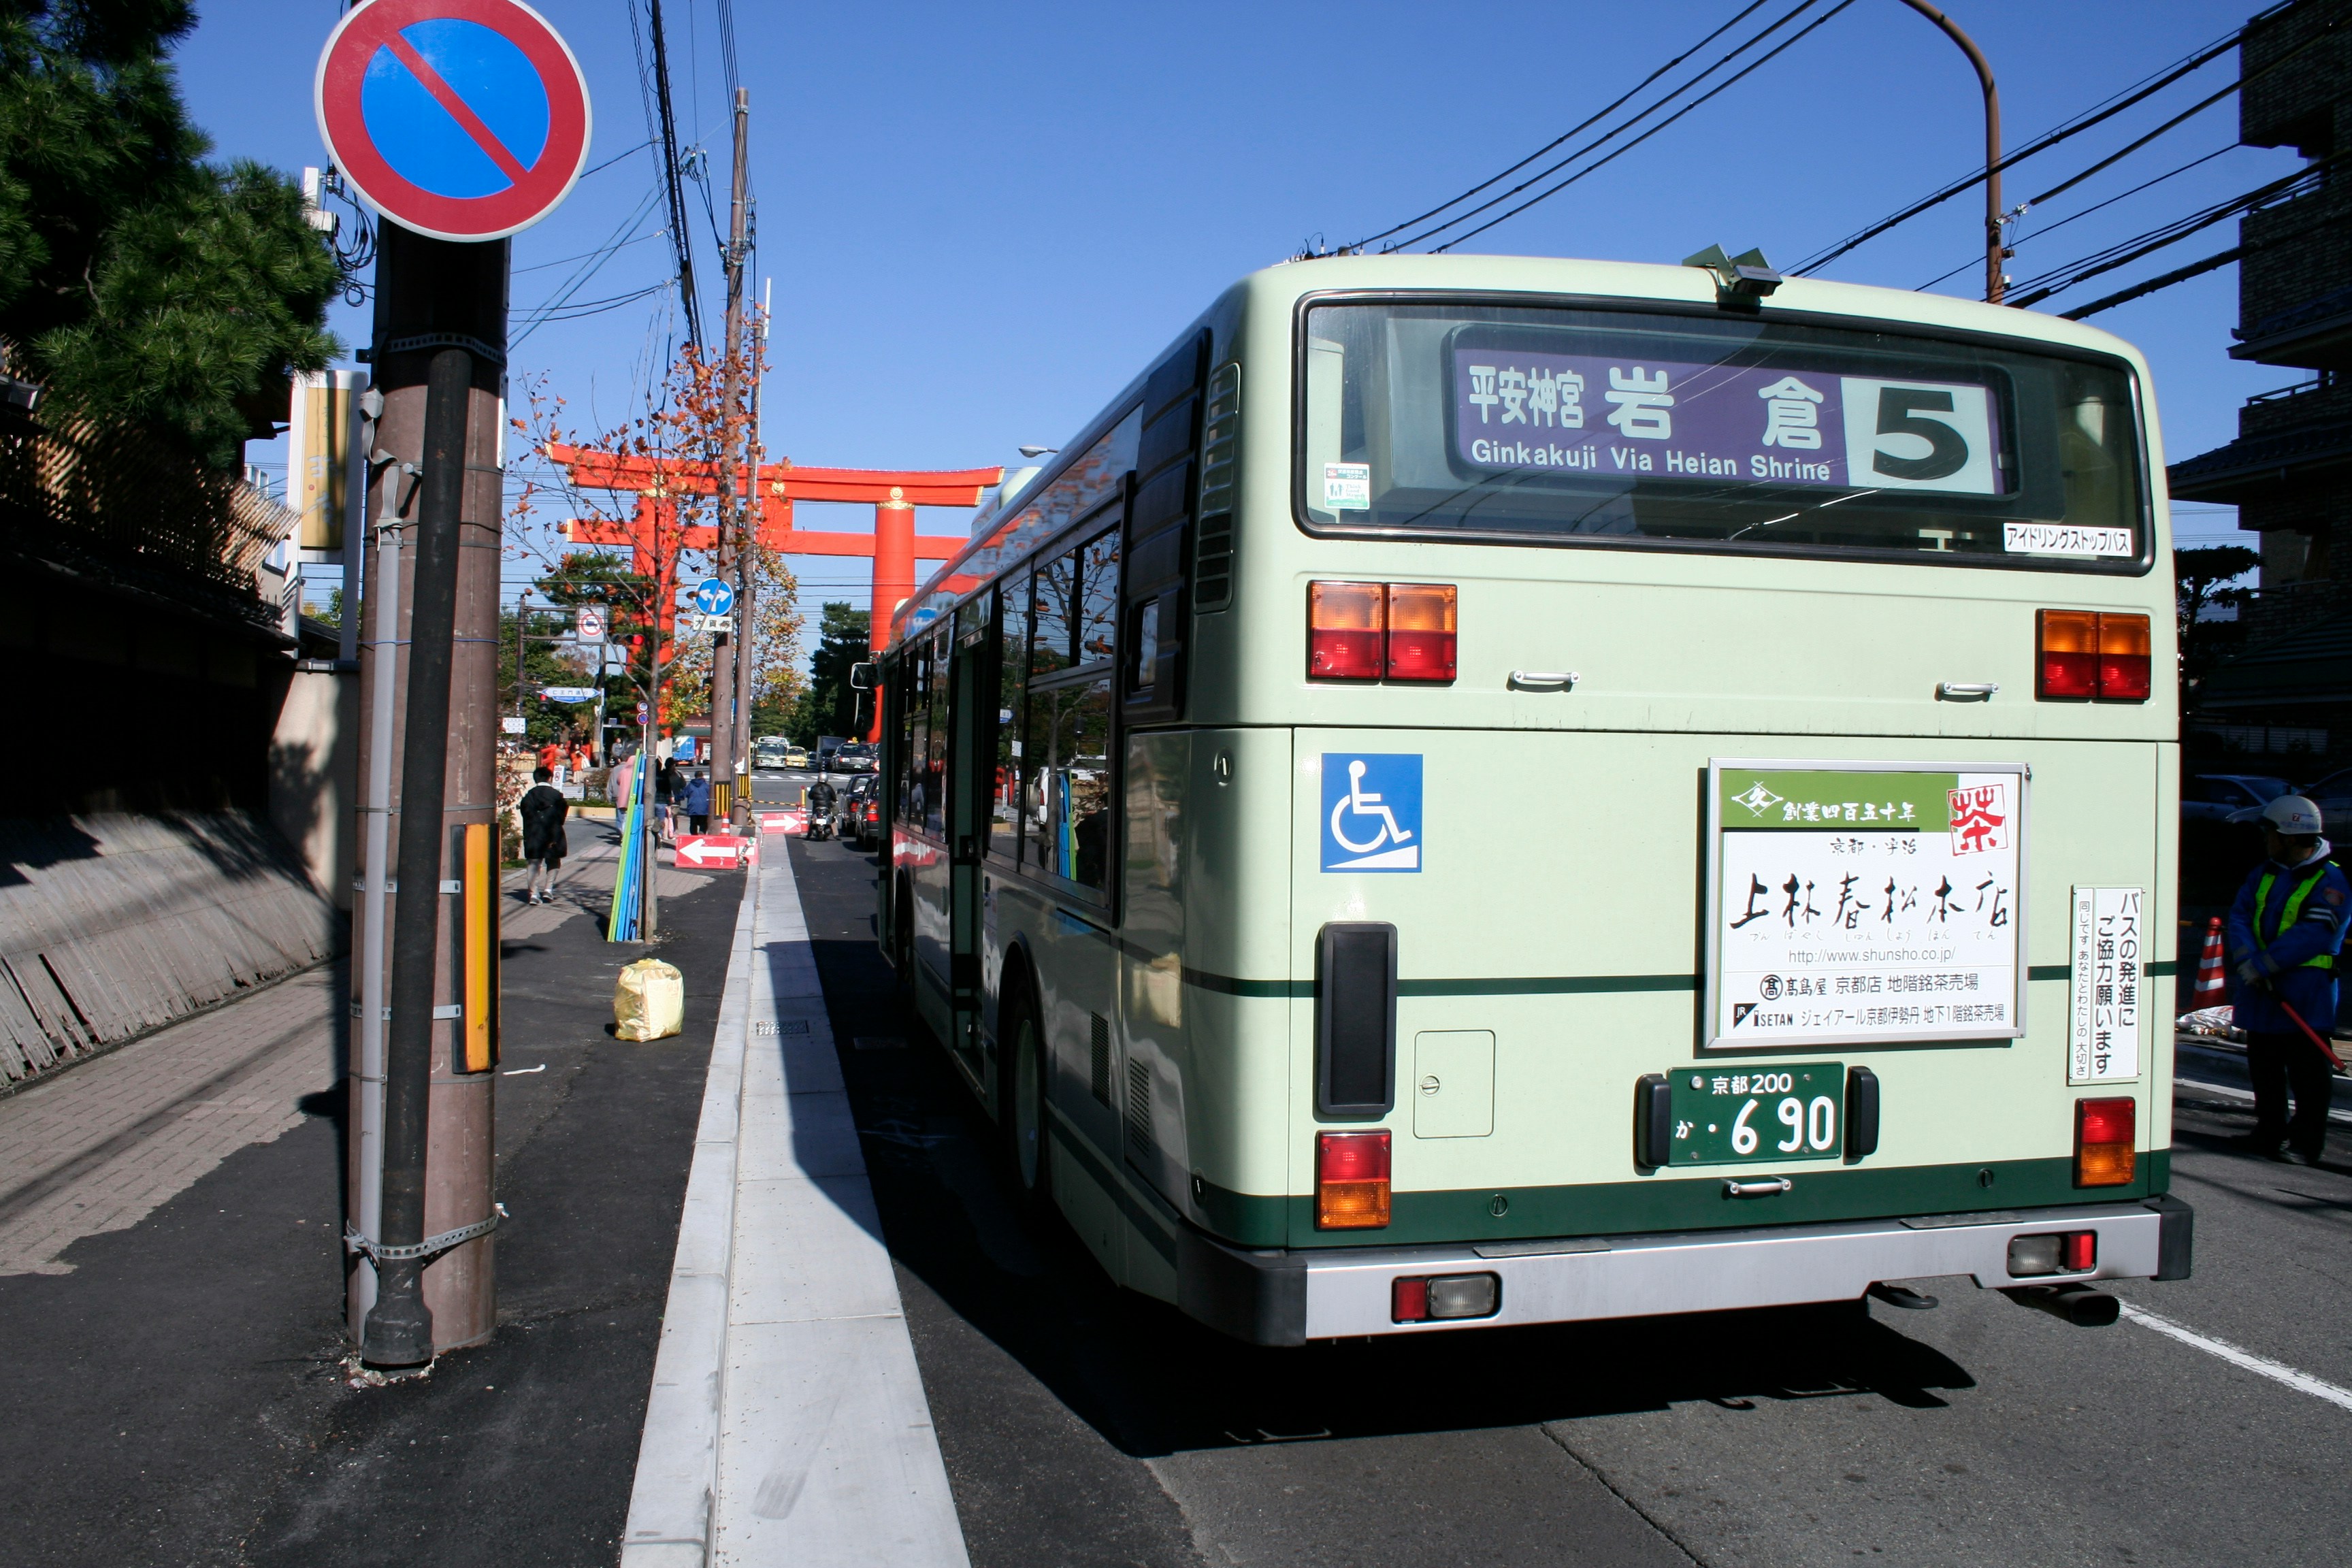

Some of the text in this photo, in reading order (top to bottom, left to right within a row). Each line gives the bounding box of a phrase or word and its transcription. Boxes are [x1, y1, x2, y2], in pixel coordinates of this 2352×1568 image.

[1469, 365, 1584, 429] 平安神宮
[1873, 387, 1970, 480] 5
[1471, 439, 1831, 482] Ginkakuji Via Heian Shrine
[2006, 527, 2129, 552] アイドリングストップバス
[1749, 787, 1771, 808] 久
[1782, 801, 1916, 822] 創業四百五十年
[1950, 787, 2006, 851] 茶
[1829, 837, 1917, 856] 京都・宇治
[1730, 870, 2008, 930] 上林春松本店
[1788, 947, 1955, 965] http://www.shunsho.co.jp/
[2118, 893, 2140, 1027] バスの発進に
[1835, 977, 1882, 994] 京都店
[1887, 973, 1979, 992] 地階銘茶売場
[2075, 900, 2090, 1077] 同じです あなたとわたしの 大切さ
[2094, 915, 2116, 1075] ご協力願います
[1801, 1007, 1920, 1026] ジェイアール京都伊勢丹
[1923, 1004, 2005, 1024] 地下1階銘茶売場
[1711, 1073, 1793, 1095] 京都200
[1675, 1120, 1695, 1139] か
